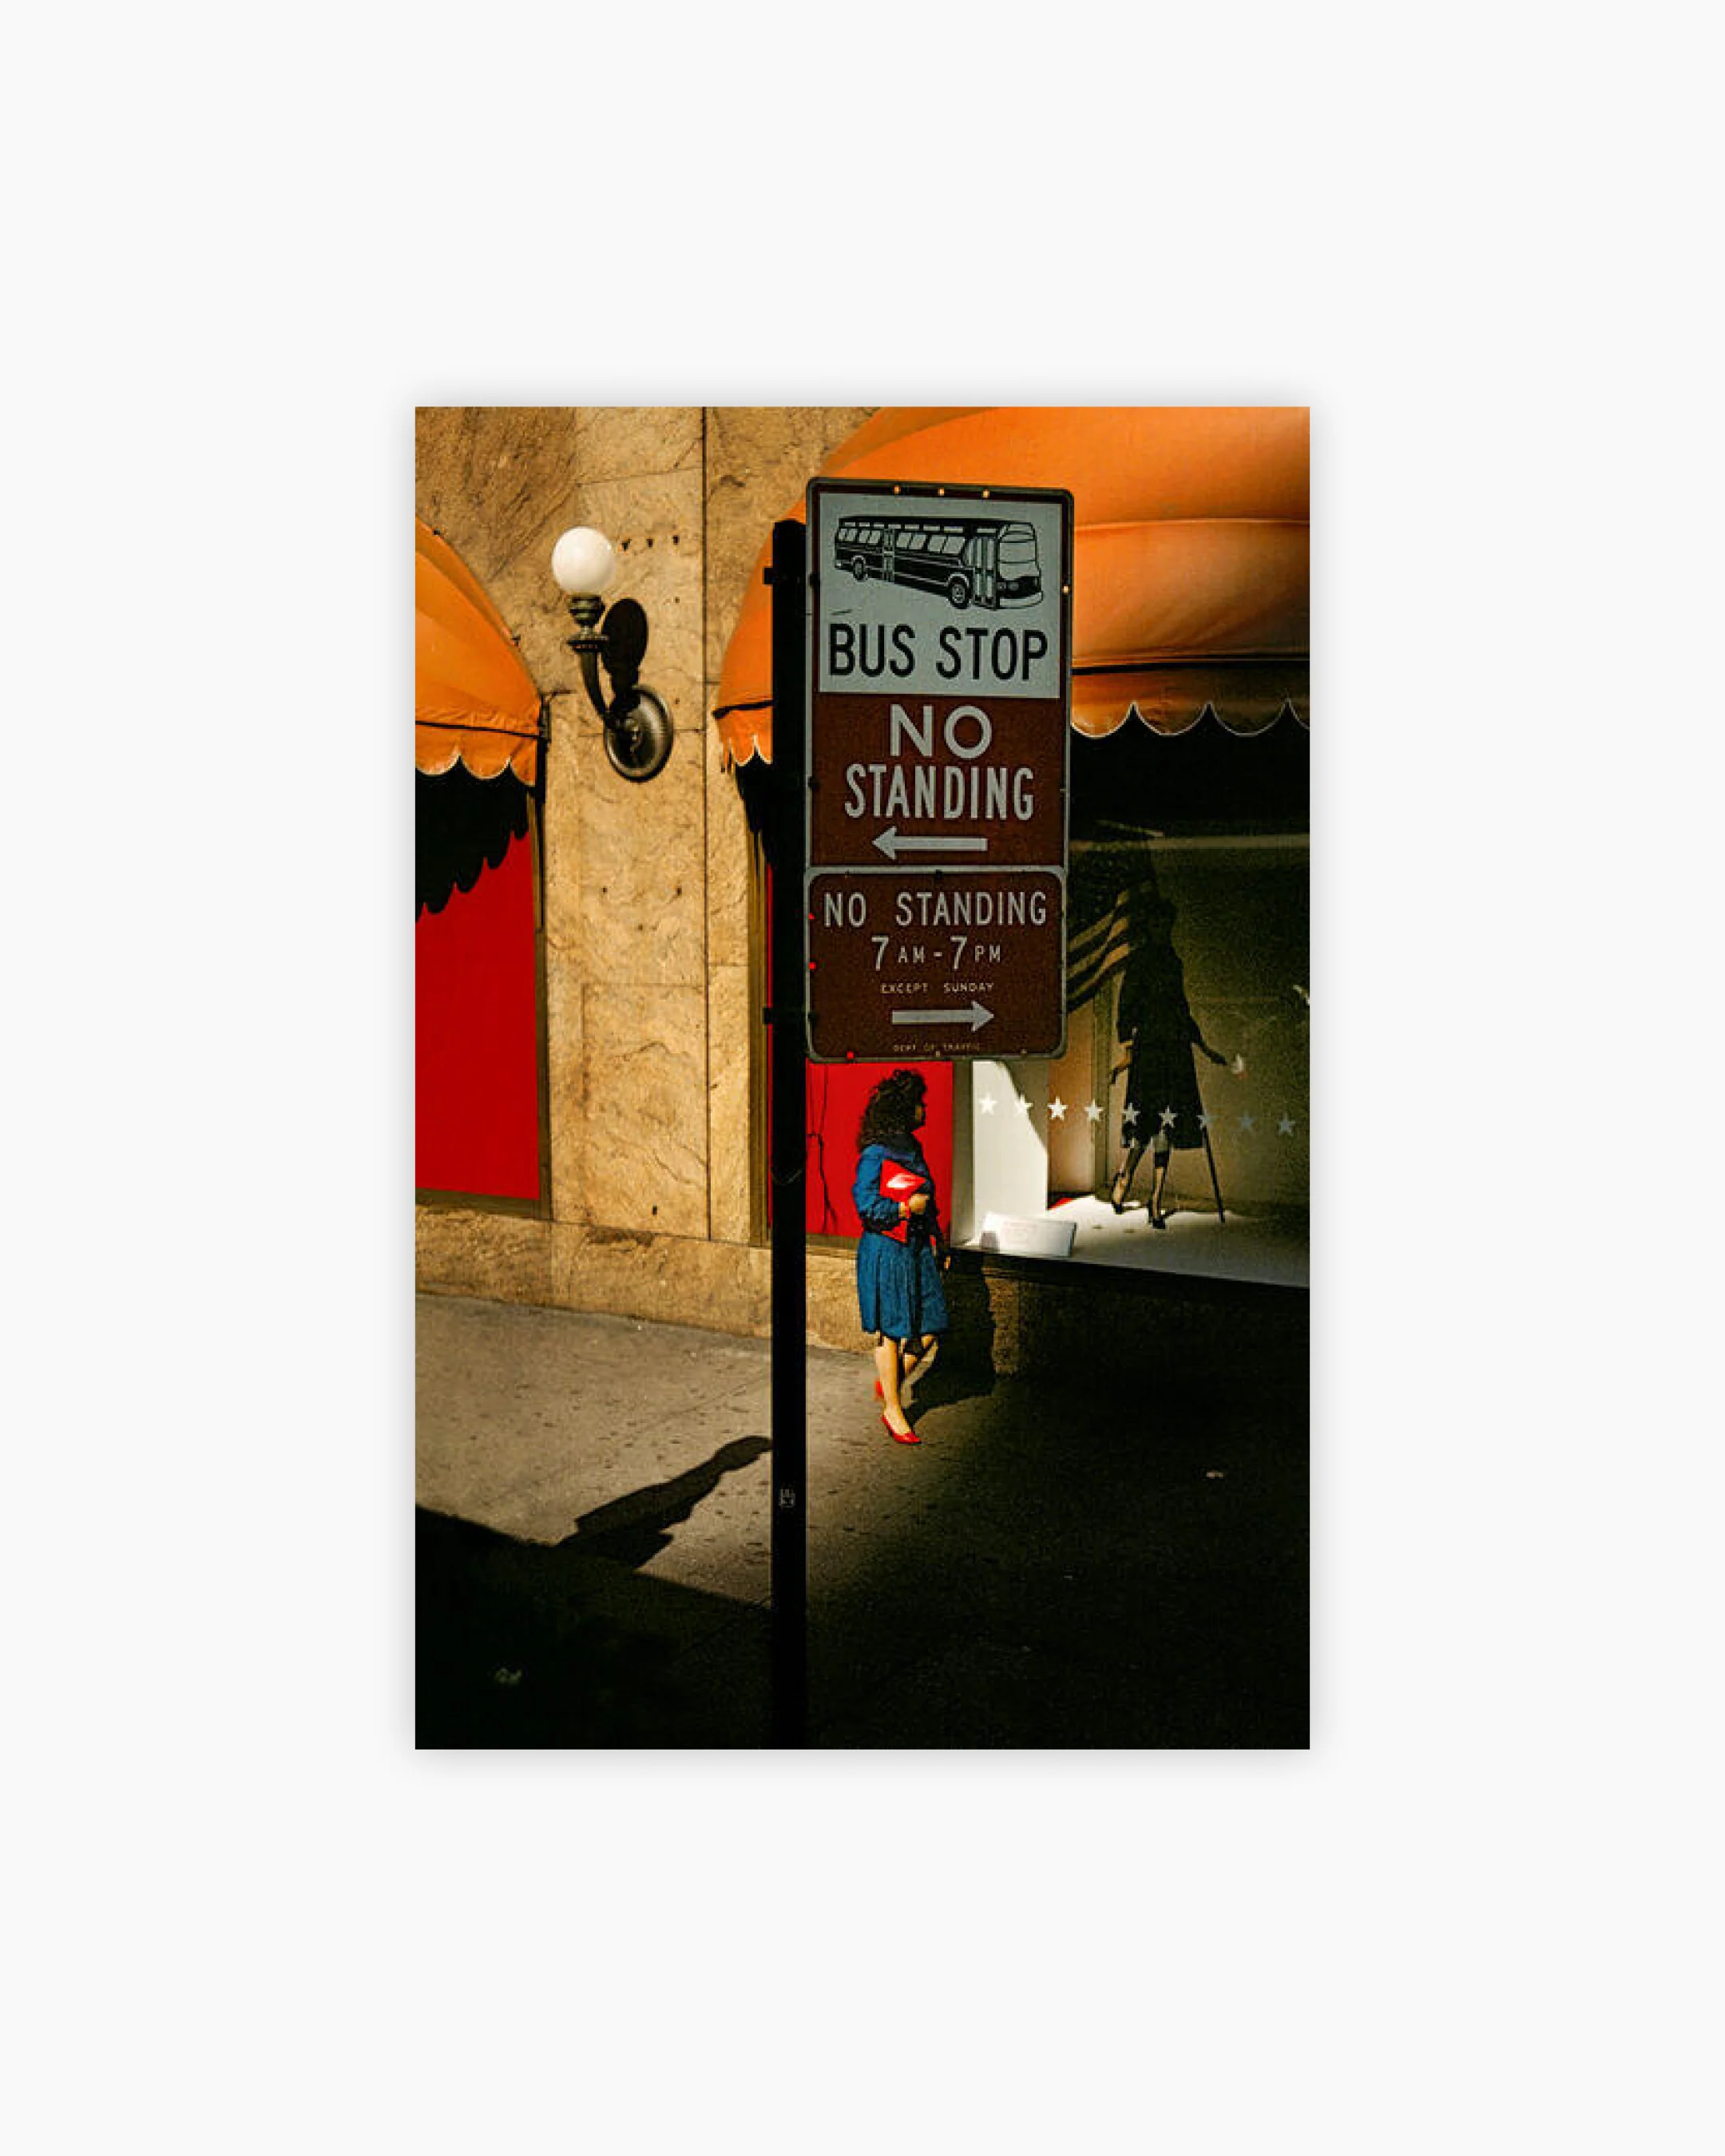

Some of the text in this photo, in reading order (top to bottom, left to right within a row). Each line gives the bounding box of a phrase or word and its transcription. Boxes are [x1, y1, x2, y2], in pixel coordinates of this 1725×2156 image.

[828, 624, 1048, 680] BUS STOP
[890, 703, 992, 759] NO
[844, 764, 1033, 819] STANDING
[823, 890, 1046, 928] NO STANDING
[880, 982, 993, 993] EXCEPT SUNDAY
